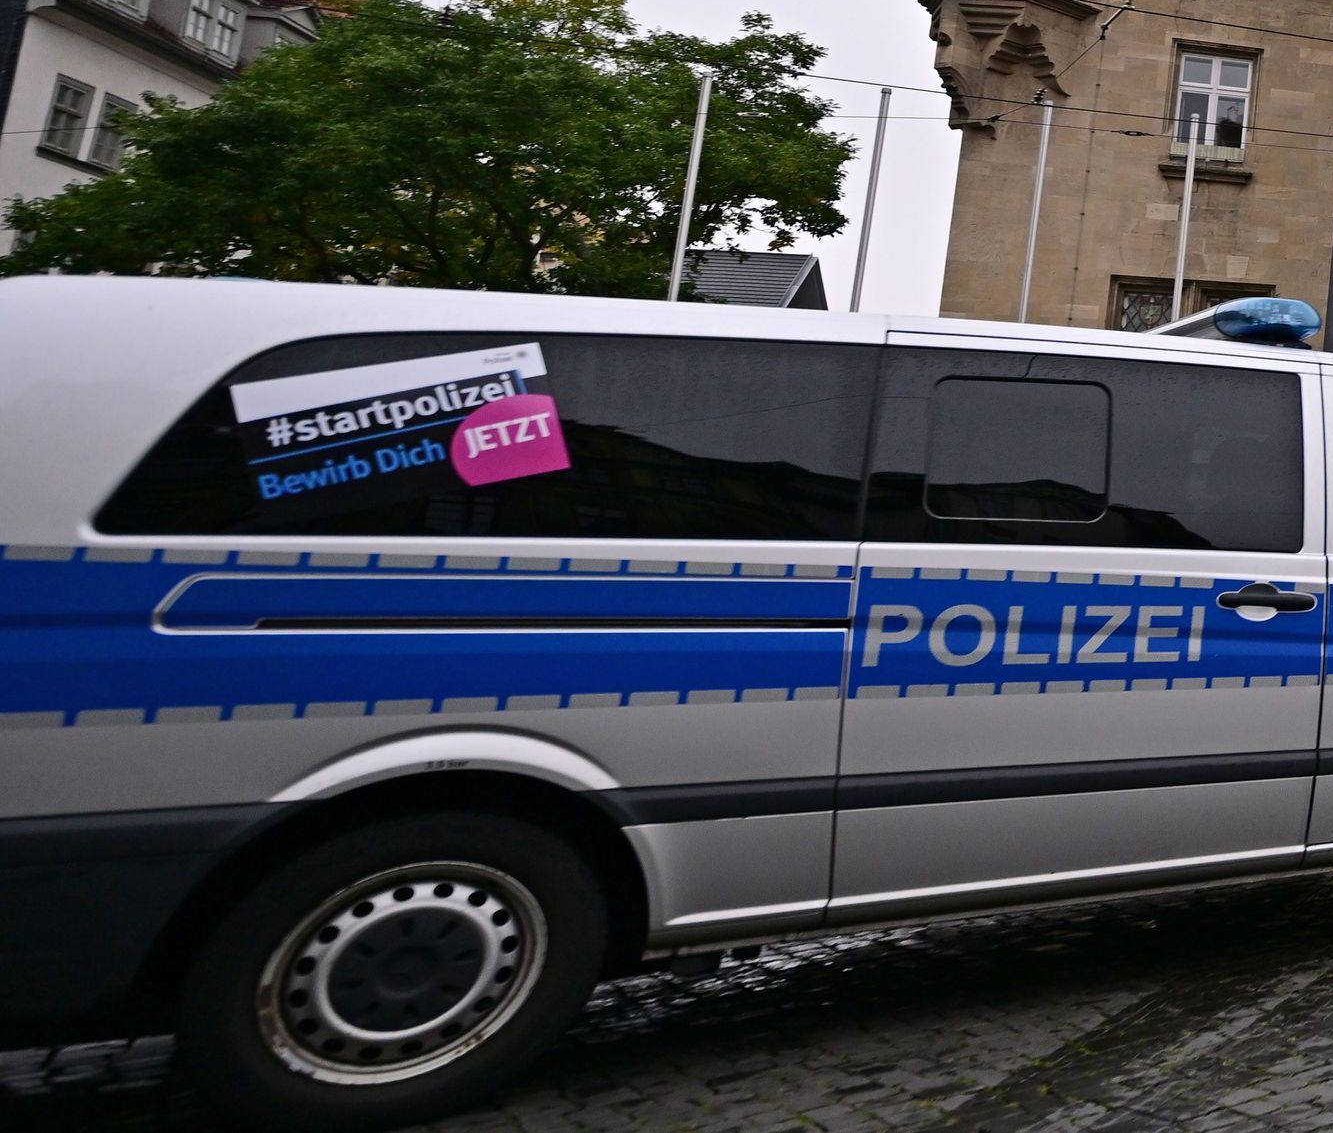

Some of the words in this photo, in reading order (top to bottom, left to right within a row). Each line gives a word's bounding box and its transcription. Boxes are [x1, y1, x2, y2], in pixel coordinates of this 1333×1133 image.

[266, 373, 516, 448] #startpolizei
[463, 412, 550, 459] JETZT
[258, 456, 372, 499] Bewirb
[375, 438, 446, 473] Dich
[861, 603, 1206, 668] POLIZEI
